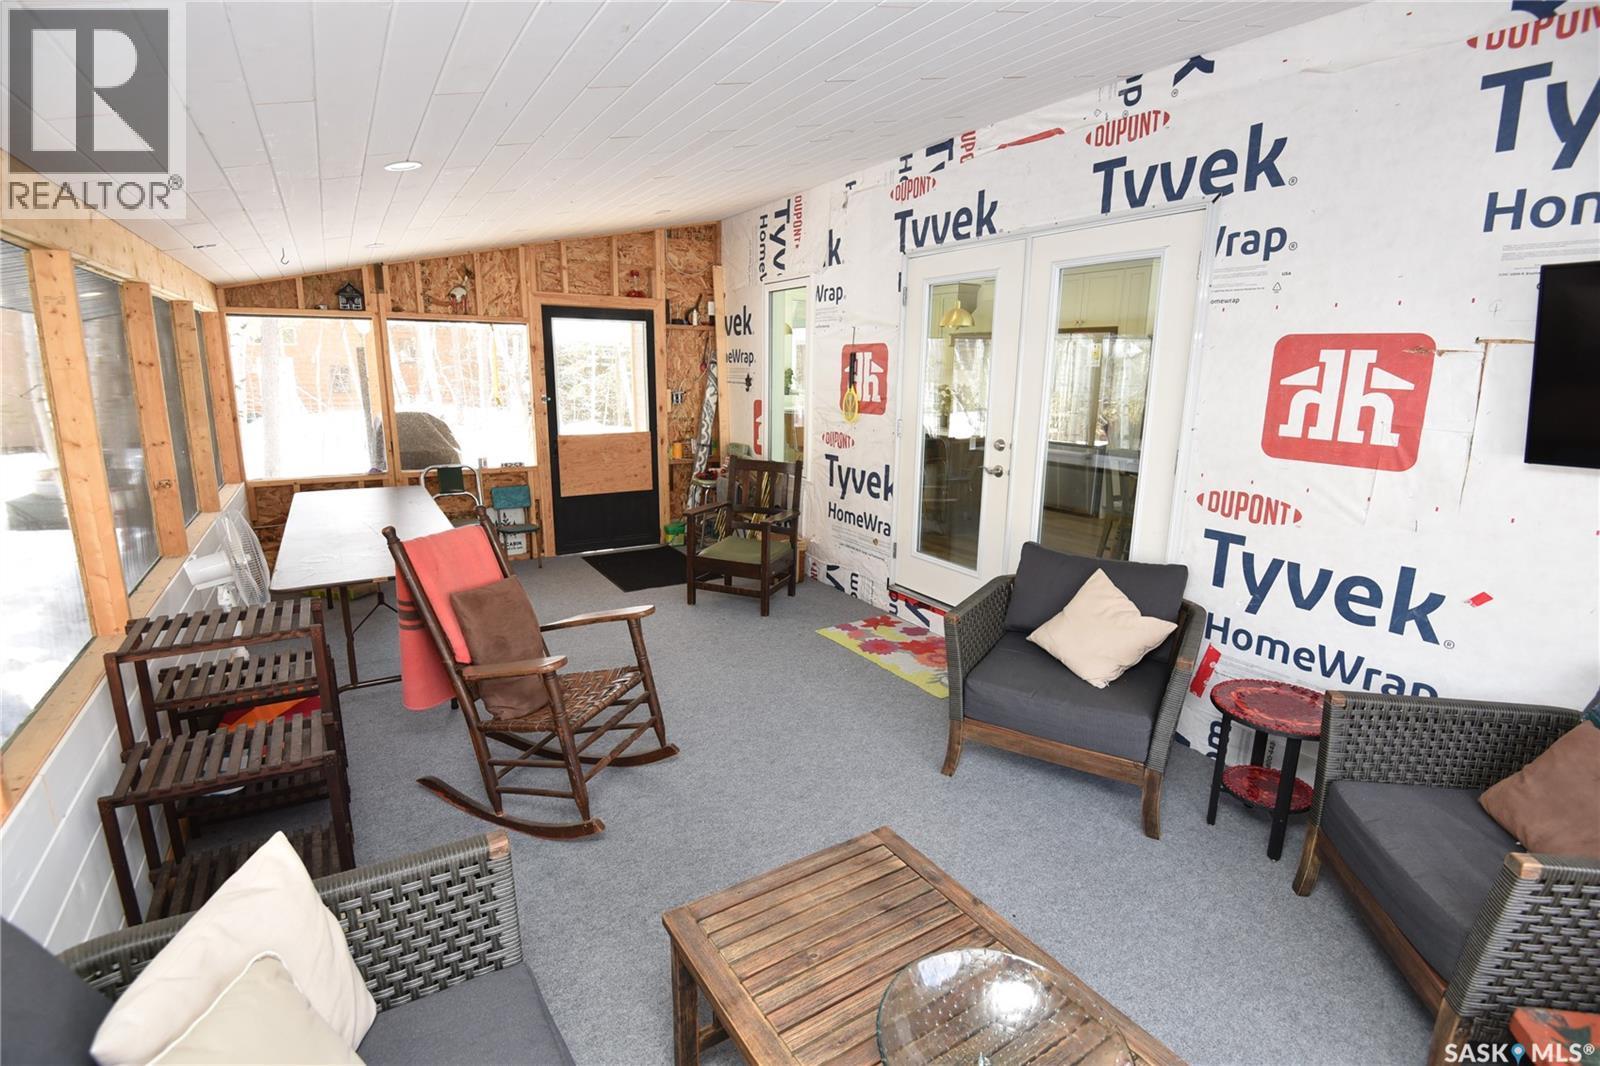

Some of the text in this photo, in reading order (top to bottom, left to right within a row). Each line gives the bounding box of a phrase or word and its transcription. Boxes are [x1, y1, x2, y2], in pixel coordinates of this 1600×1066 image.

[1481, 61, 1600, 170] Ty
[816, 284, 844, 305] Wrap
[724, 305, 752, 336] vek
[726, 349, 754, 367] eWrap
[828, 501, 891, 537] HomeWra
[1207, 490, 1291, 525] DUPONT
